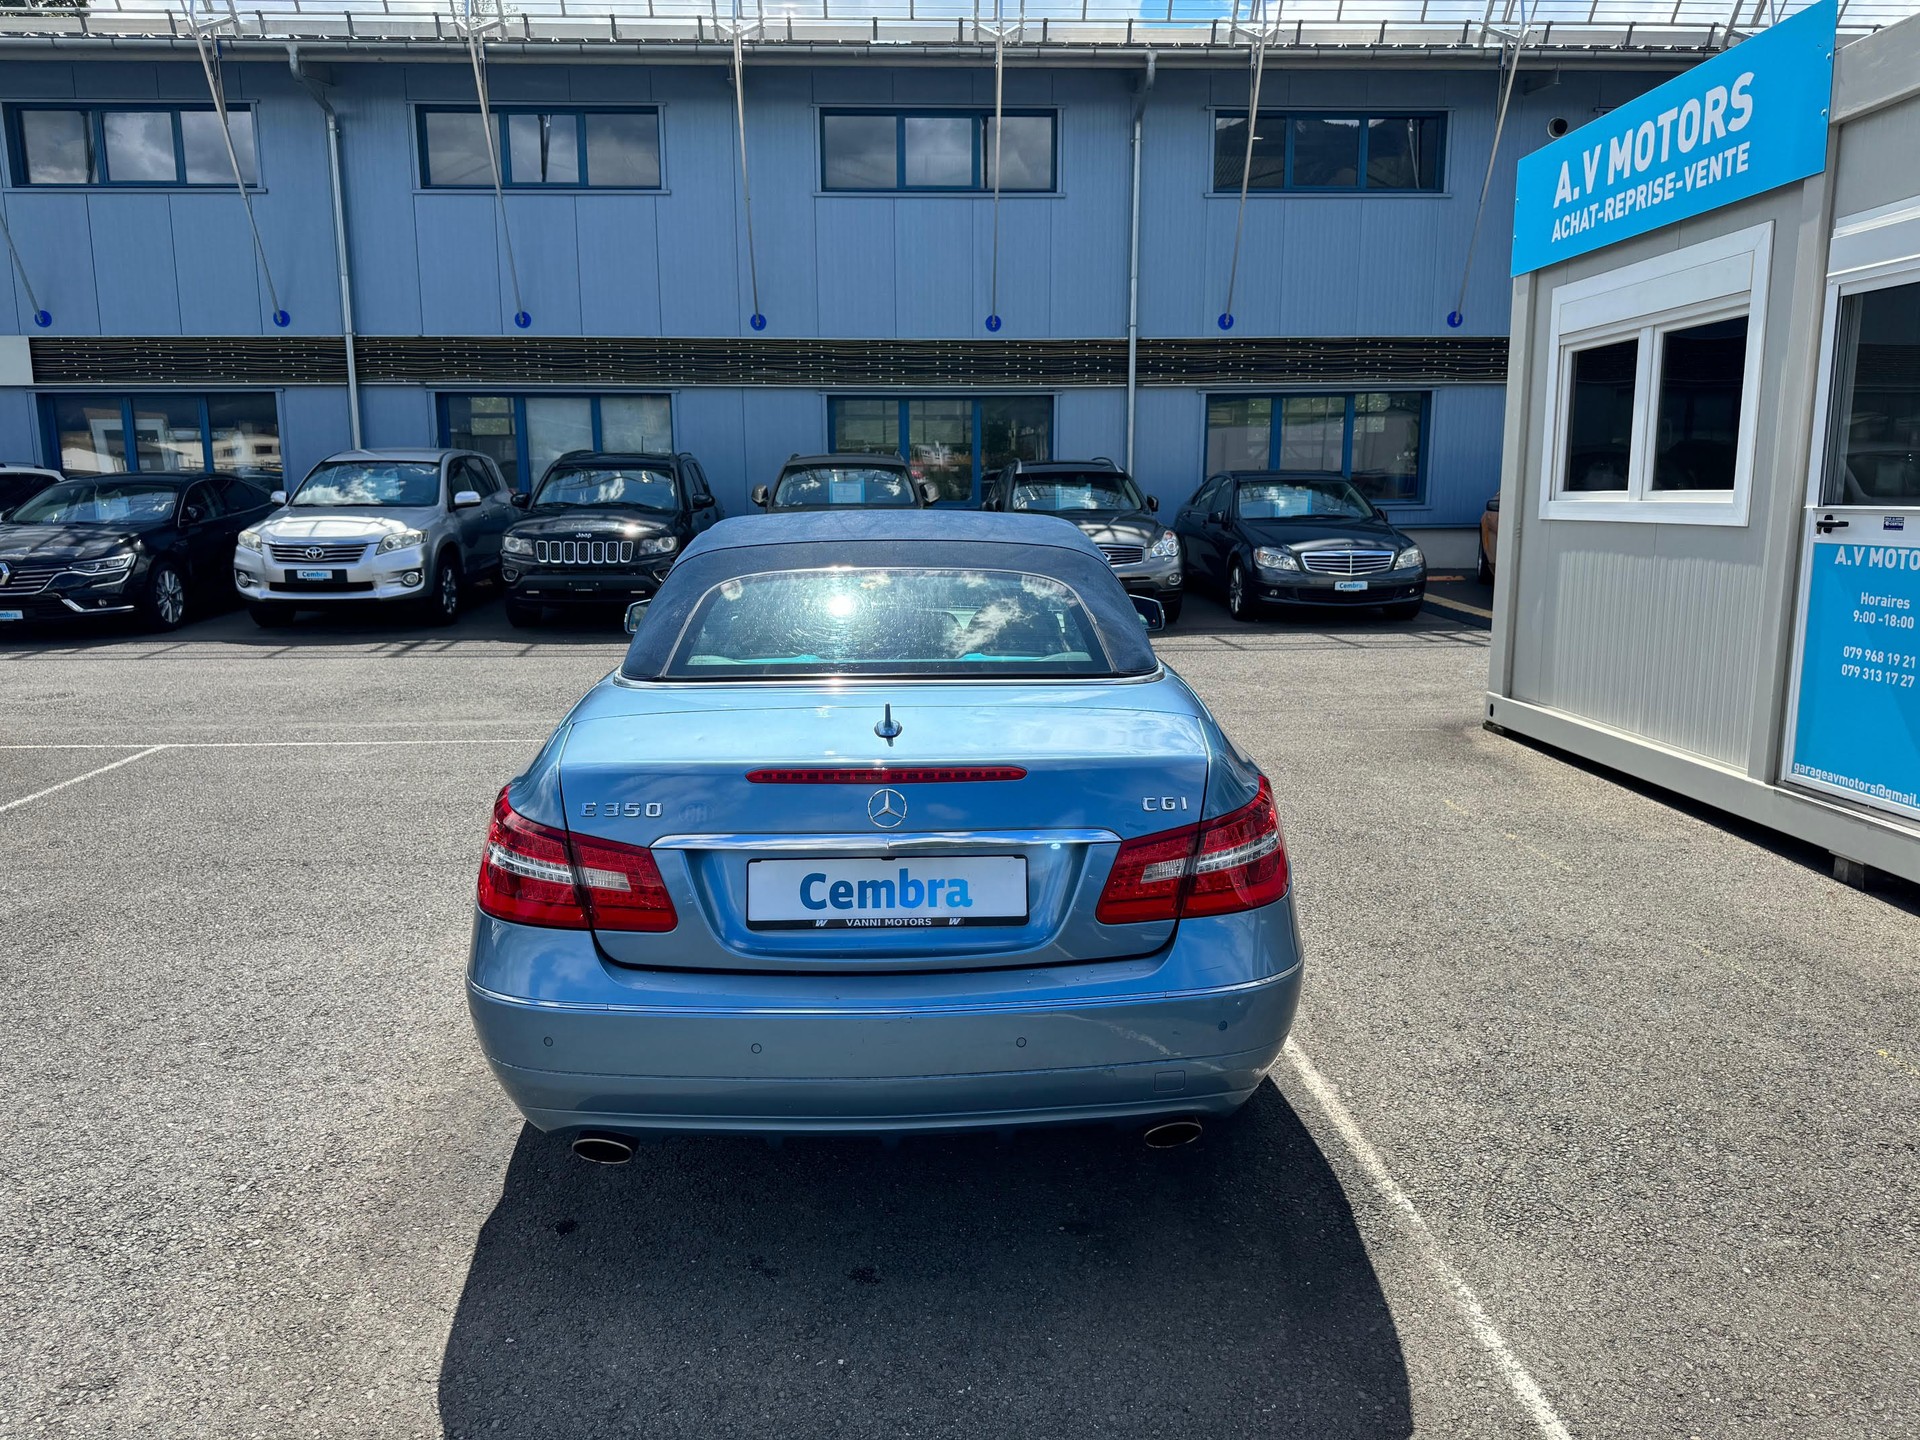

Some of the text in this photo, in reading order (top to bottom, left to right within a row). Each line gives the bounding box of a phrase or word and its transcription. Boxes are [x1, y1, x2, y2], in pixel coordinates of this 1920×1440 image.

[1553, 71, 1755, 208] A.V MOTORS
[1551, 141, 1751, 243] ACHAT-REPRISE-VENTE
[1834, 546, 1920, 570] A.V MOTO
[1860, 592, 1910, 609] Horaires
[1853, 610, 1876, 624] 9:00
[1843, 646, 1916, 669] 079 968 19 21
[1841, 664, 1915, 688] 079 313 17 27
[580, 802, 664, 817] E 350
[1141, 796, 1188, 811] CGI
[799, 868, 973, 910] Cembra
[845, 918, 881, 927] VANNI
[885, 917, 932, 927] MOTORS
